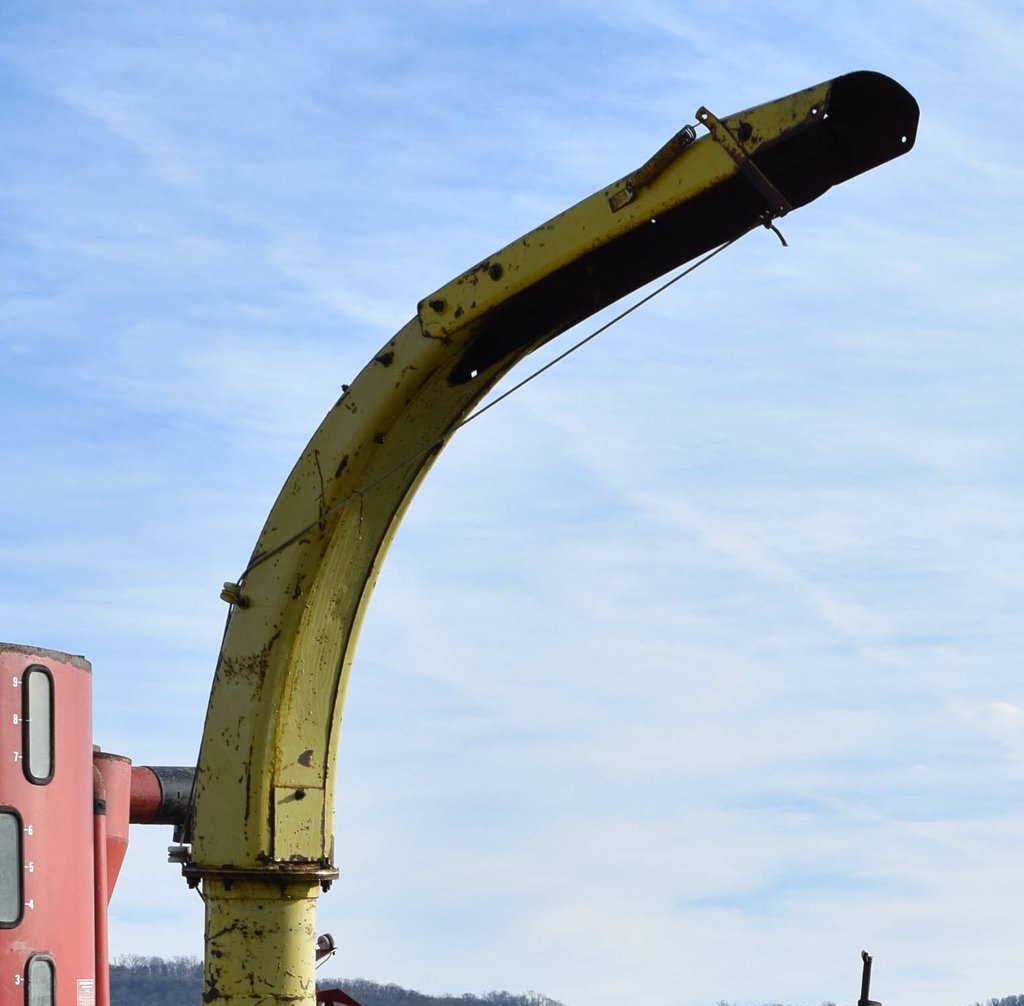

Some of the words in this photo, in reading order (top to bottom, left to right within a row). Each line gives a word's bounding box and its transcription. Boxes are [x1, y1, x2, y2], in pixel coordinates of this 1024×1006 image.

[13, 677, 18, 687] 9
[13, 714, 18, 725] 8
[13, 751, 19, 762] 7
[28, 825, 33, 836] 6
[29, 861, 34, 873] 5
[29, 898, 34, 910] 4
[15, 974, 20, 985] 3
